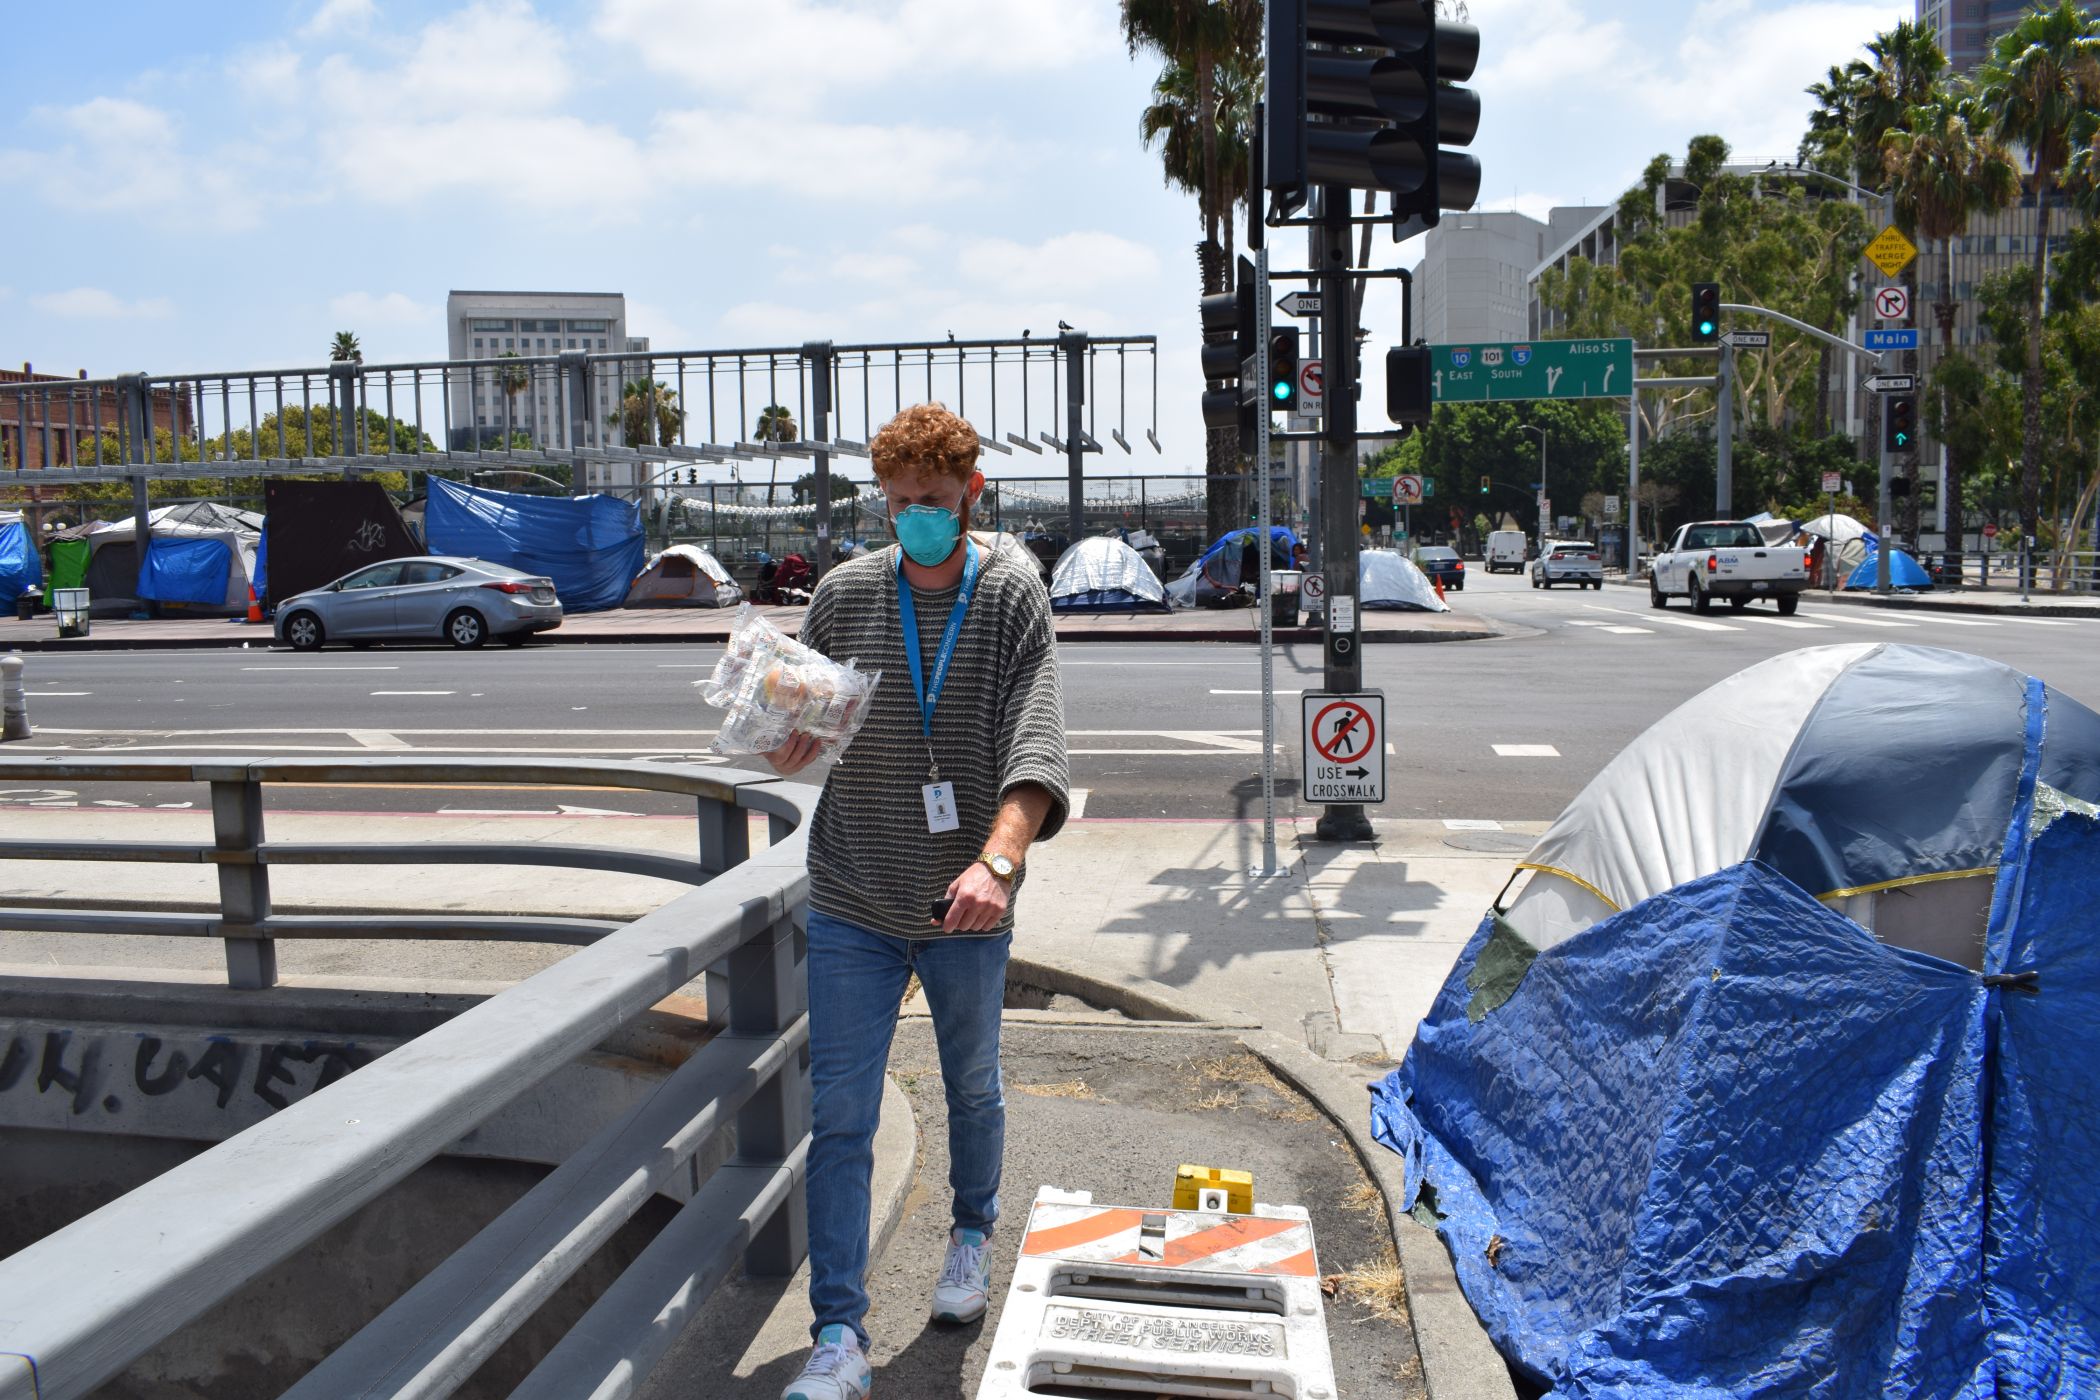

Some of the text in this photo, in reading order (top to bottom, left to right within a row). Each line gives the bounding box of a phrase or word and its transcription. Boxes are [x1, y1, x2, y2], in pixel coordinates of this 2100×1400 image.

[1298, 300, 1319, 309] ONE
[1873, 334, 1909, 344] Main
[1569, 343, 1615, 354] Aliso St
[1455, 352, 1526, 364] 10 101 5
[1449, 370, 1522, 380] EAST SOUTH
[1317, 767, 1342, 779] USE
[1313, 785, 1376, 797] CROSSWALK
[1082, 1311, 1247, 1332] CITY OF LOS ANGELES
[1056, 1316, 1272, 1343] DEPT. OF PUBLIC WORKS
[1051, 1327, 1275, 1356] STREET SERVICES
